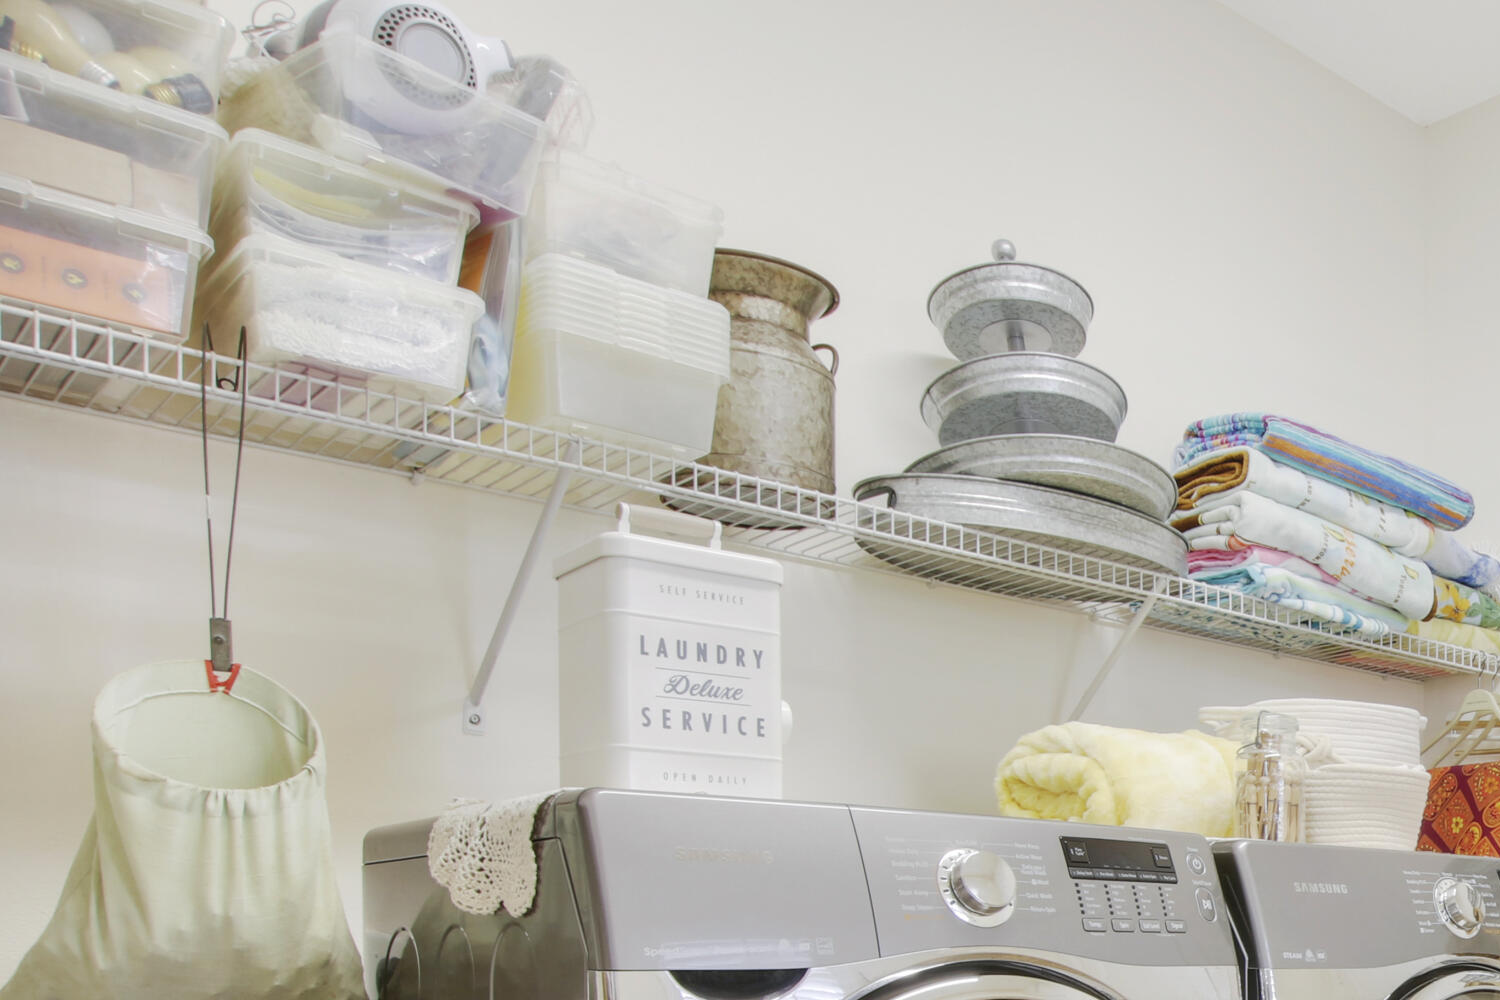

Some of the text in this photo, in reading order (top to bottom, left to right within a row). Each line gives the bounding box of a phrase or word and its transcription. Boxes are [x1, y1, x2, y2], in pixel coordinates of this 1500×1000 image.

[696, 590, 745, 605] SERVICE
[640, 635, 763, 669] LAUNDRY
[663, 674, 744, 701] Deluxe
[641, 707, 765, 737] SERVICE
[663, 771, 747, 785] OPEN DAILY
[1293, 882, 1348, 894] SAMSUNG
